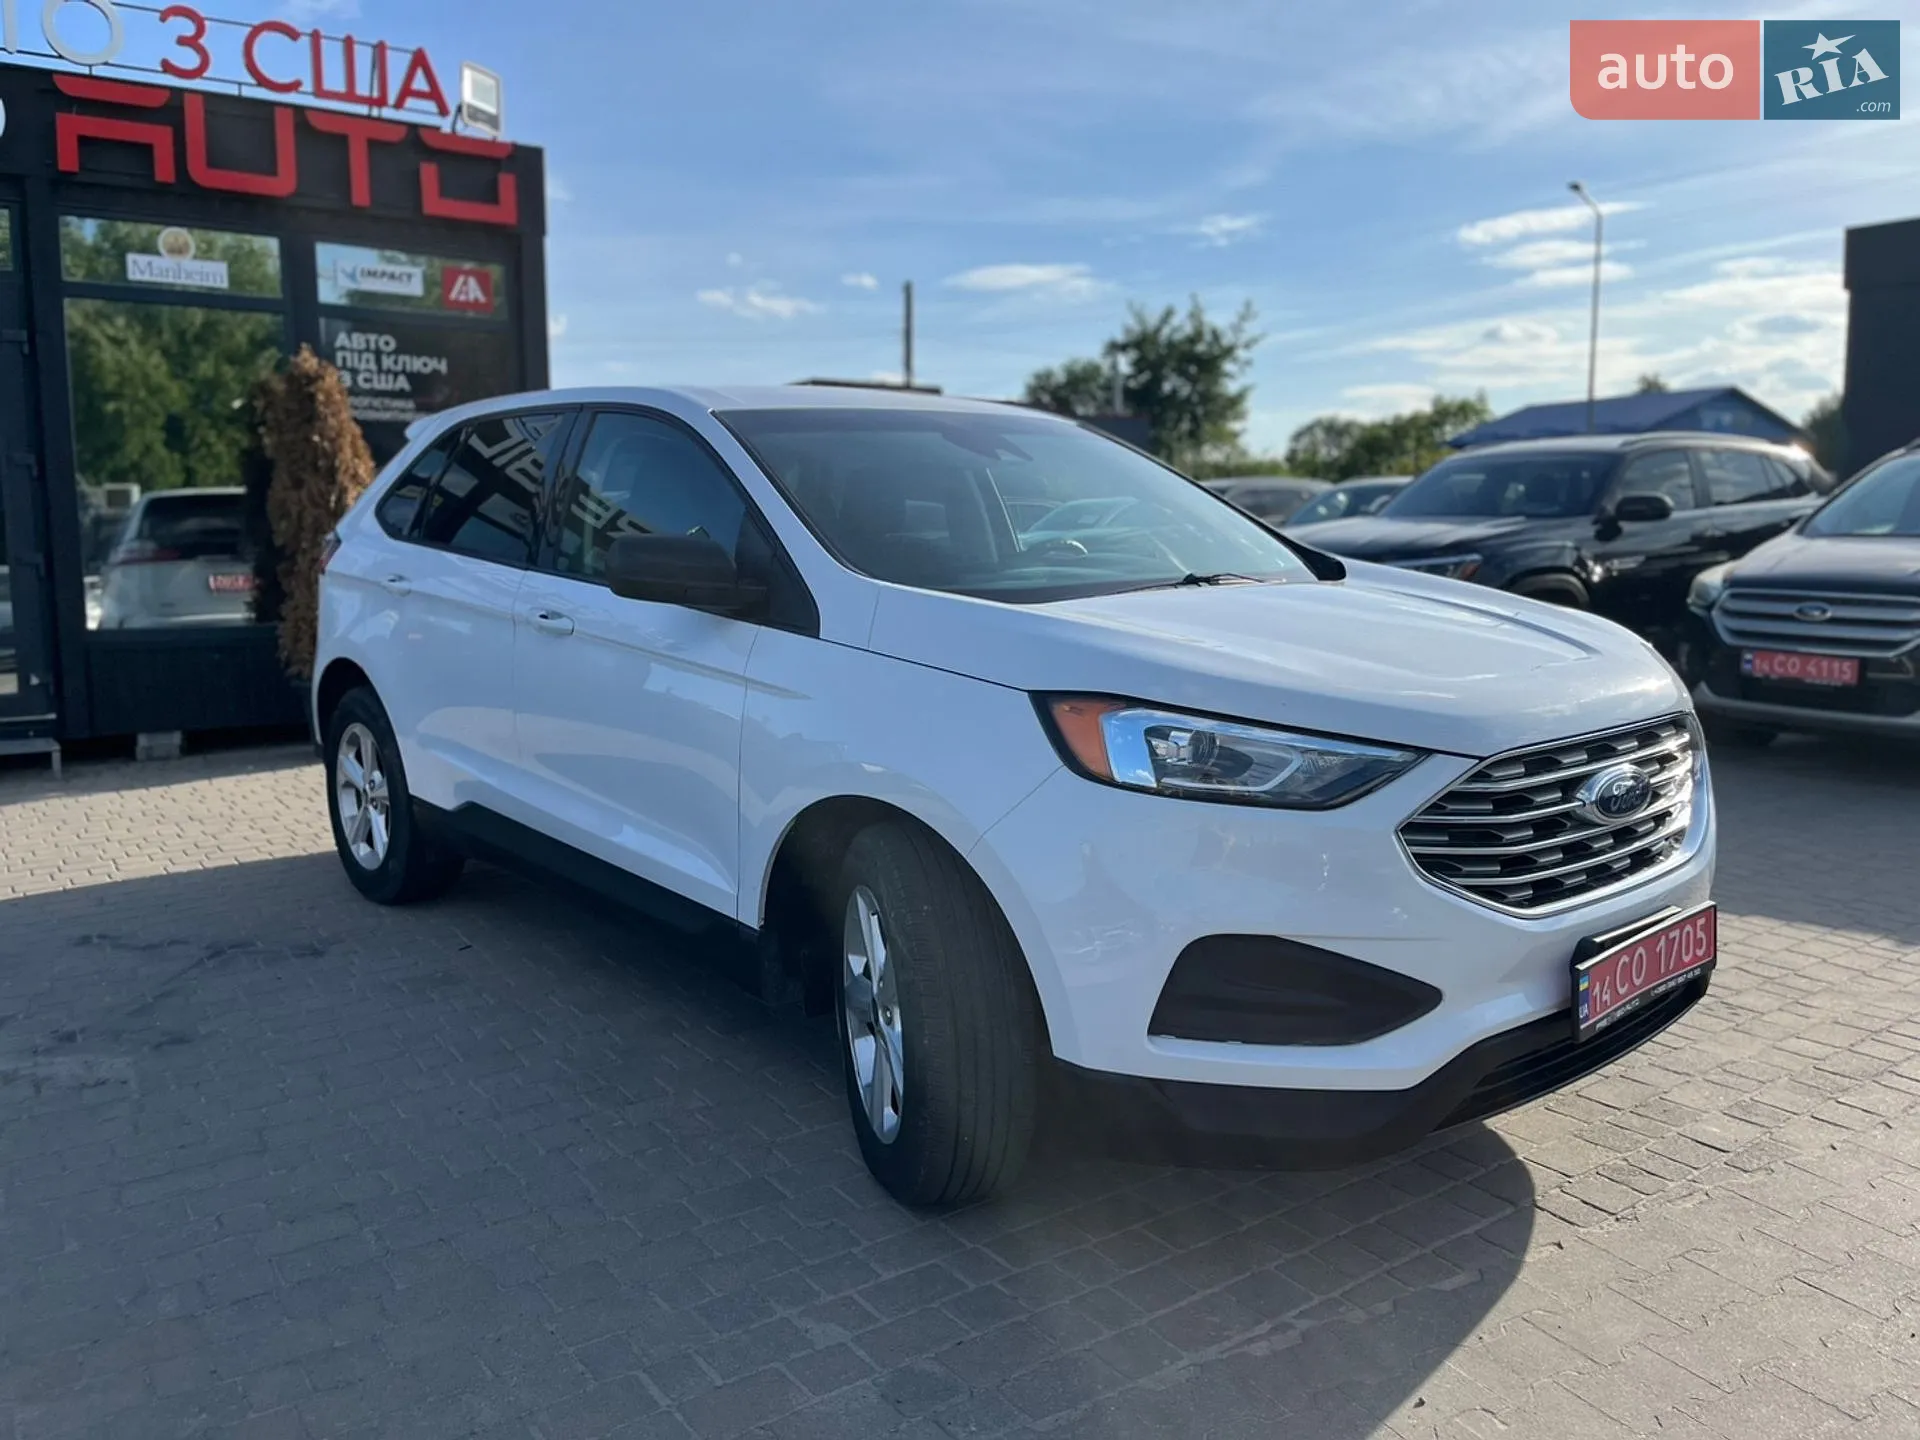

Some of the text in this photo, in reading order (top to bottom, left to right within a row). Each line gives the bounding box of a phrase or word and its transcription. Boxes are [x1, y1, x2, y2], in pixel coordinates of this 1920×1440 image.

[244, 20, 450, 117] США
[52, 74, 518, 225] AUTO
[131, 259, 226, 285] Manheim
[359, 266, 414, 283] IMPACT
[334, 331, 397, 353] АВТО
[335, 350, 448, 375] ПІД КЛЮЧ
[357, 371, 412, 392] США
[1773, 654, 1800, 673] CO
[1806, 660, 1852, 681] 4115
[1592, 975, 1611, 1013] 14
[1616, 946, 1647, 996] CO
[1656, 917, 1707, 975] 1705
